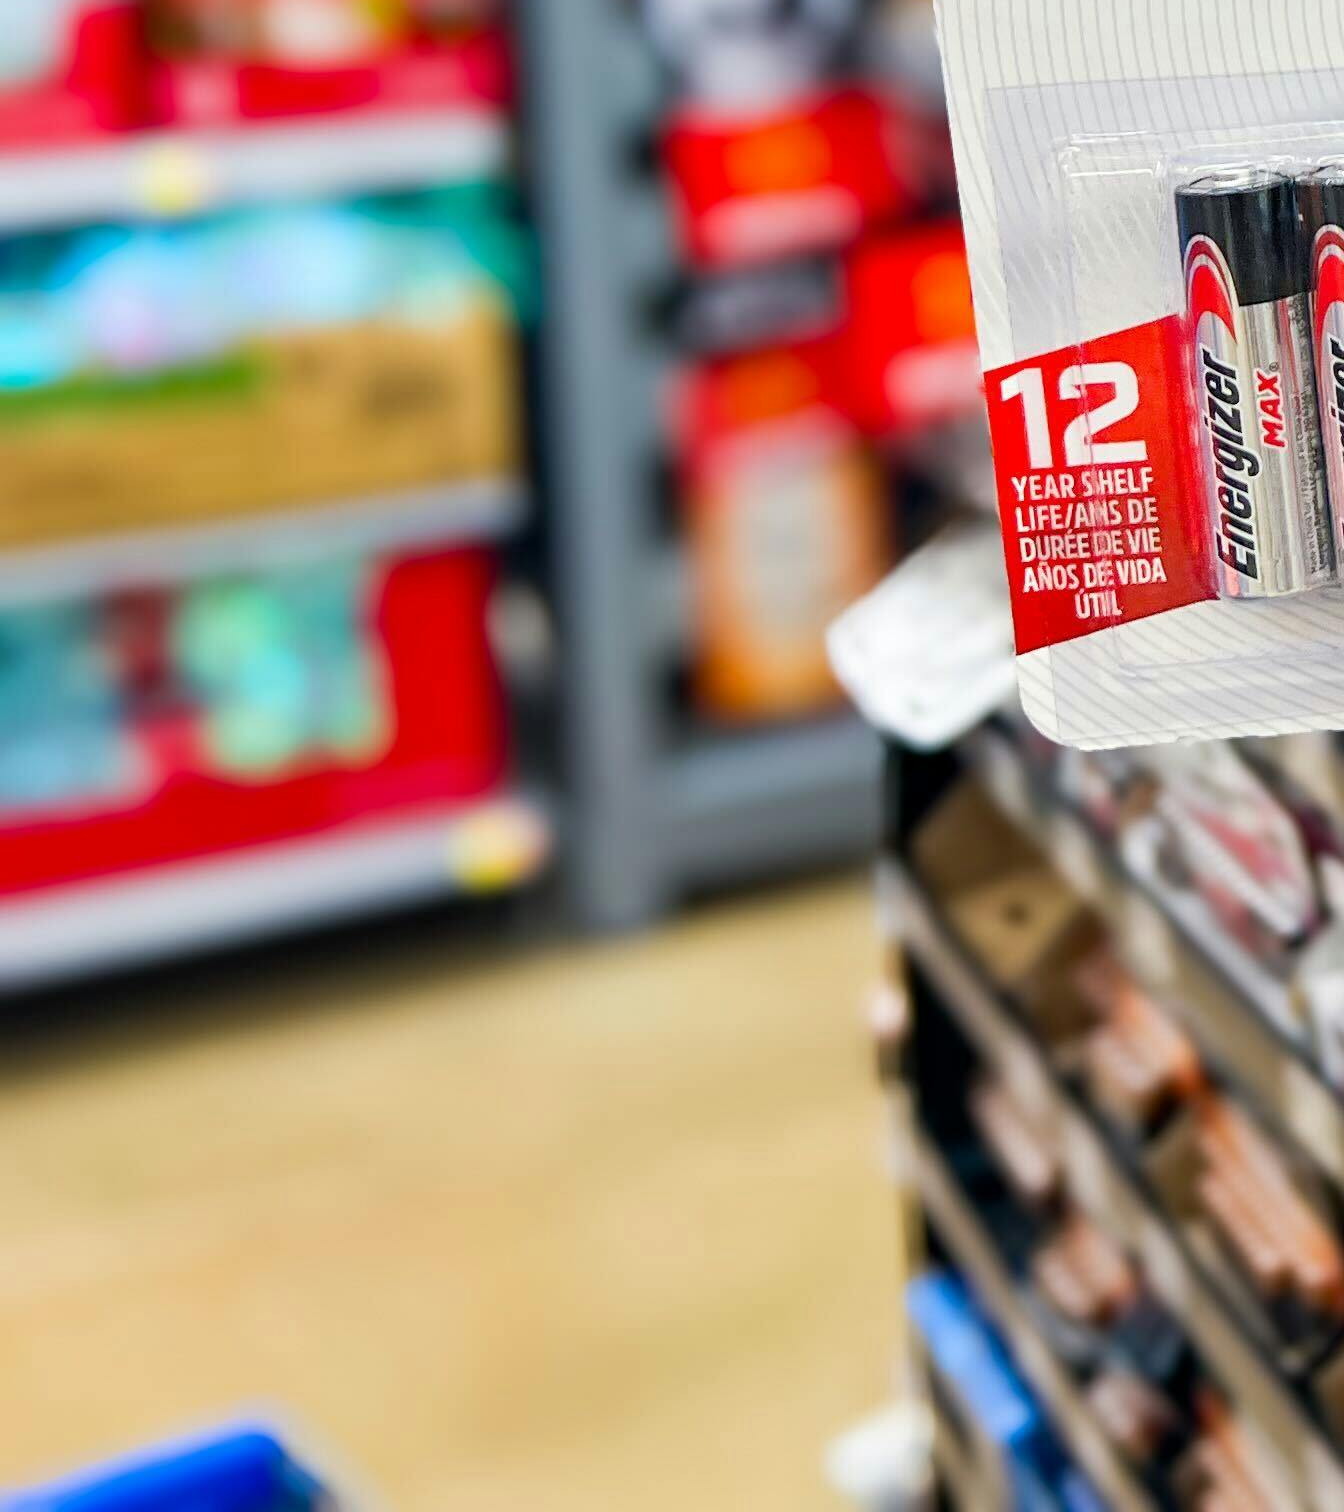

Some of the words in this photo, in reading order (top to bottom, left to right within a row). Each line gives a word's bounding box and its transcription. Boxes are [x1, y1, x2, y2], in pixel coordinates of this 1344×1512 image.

[1000, 360, 1149, 470] 12
[1255, 370, 1286, 448] MAX
[1202, 347, 1261, 580] Energizer
[1011, 473, 1076, 502] YEAR
[1081, 467, 1154, 498] SHELF
[1014, 500, 1122, 533] LIFE/ANS
[1126, 497, 1159, 525] DE
[1018, 530, 1091, 564] DURÉE
[1092, 532, 1125, 556] DE
[1124, 527, 1162, 554] VIE
[1022, 560, 1080, 593] AÑOS
[1082, 559, 1115, 589] DE
[1115, 557, 1168, 586] VIDA
